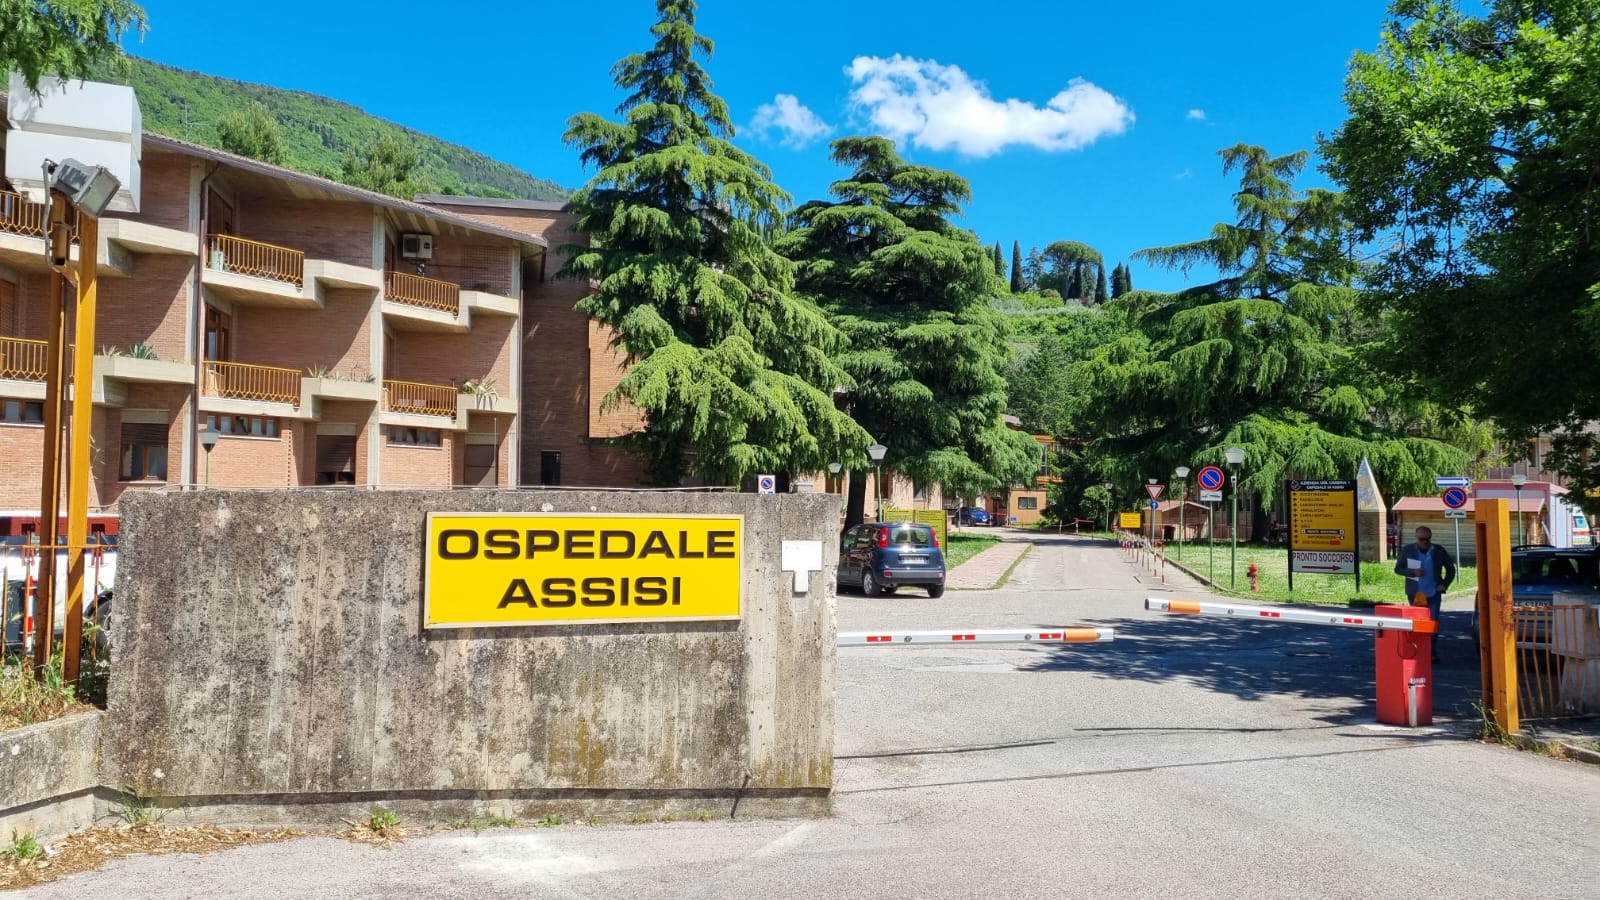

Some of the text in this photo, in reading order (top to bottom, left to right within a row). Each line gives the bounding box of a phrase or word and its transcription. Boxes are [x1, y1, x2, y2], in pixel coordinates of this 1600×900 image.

[437, 529, 736, 560] OSPEDALE
[1292, 552, 1353, 563] PRONTO SOCCORSO
[496, 576, 681, 609] ASSISI
